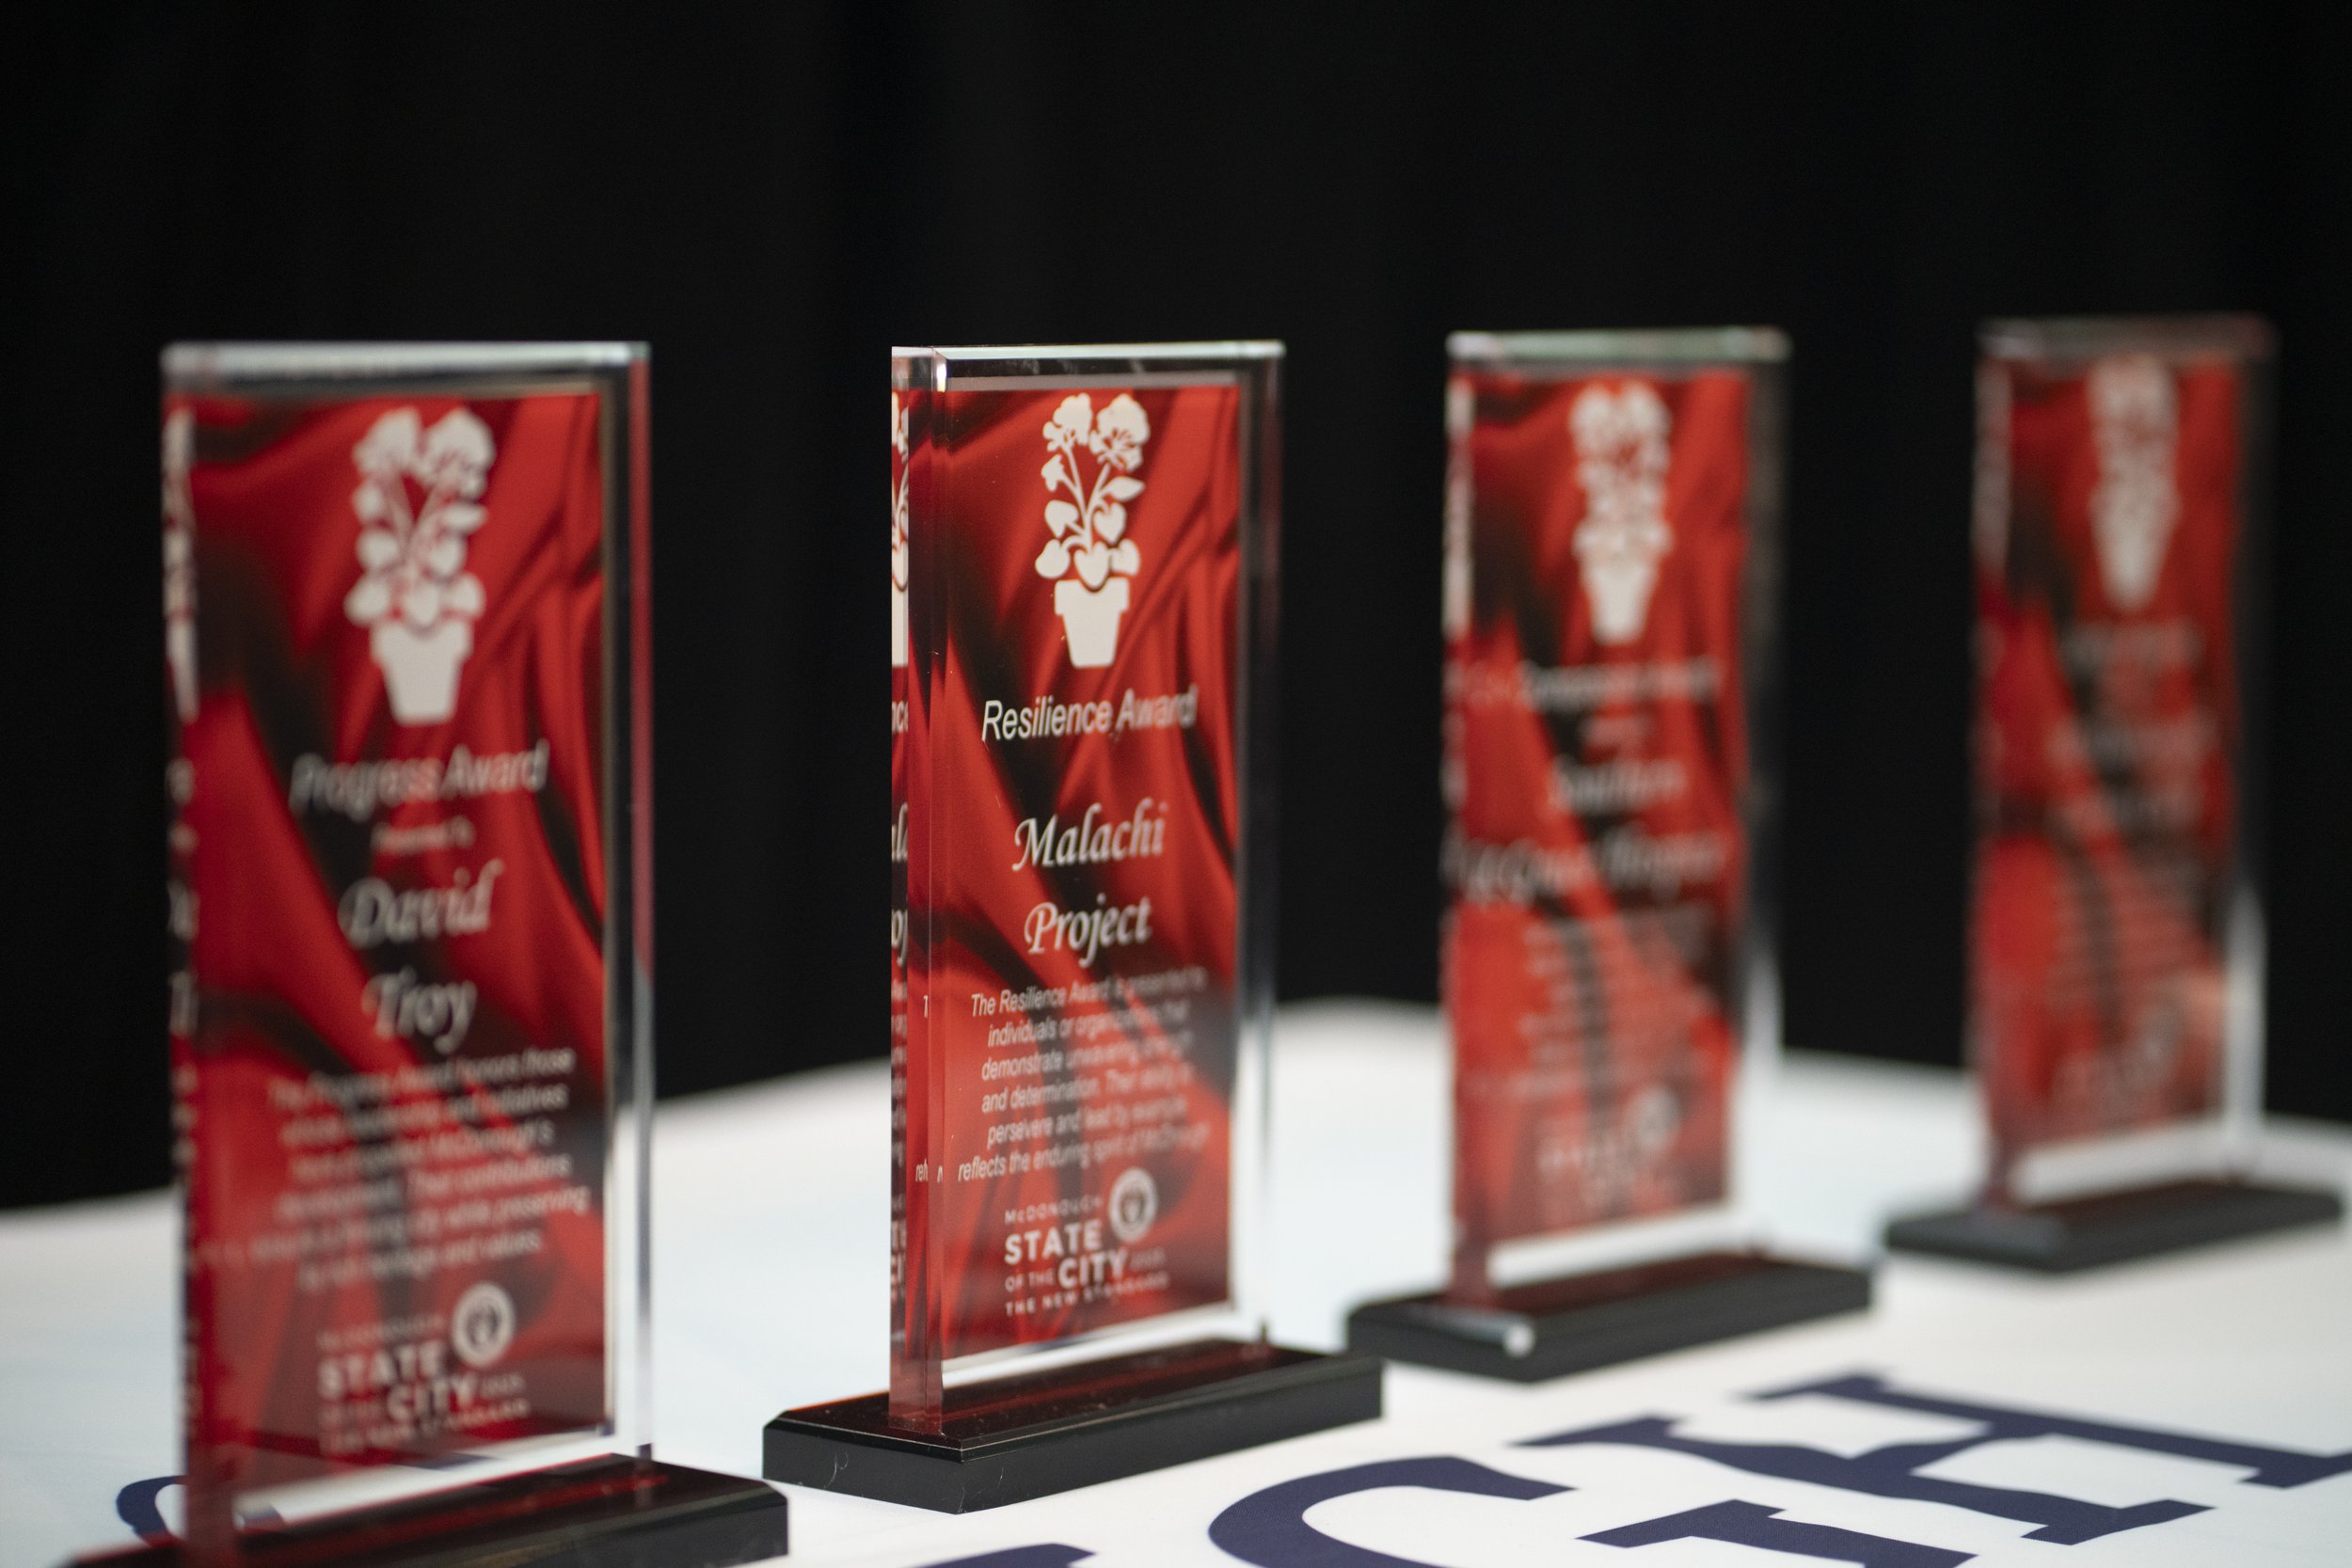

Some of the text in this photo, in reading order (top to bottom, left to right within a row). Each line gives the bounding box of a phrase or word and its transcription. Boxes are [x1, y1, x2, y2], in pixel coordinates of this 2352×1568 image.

[981, 685, 1198, 741] Resilience Award
[290, 738, 550, 822] Progress Award
[1011, 797, 1168, 871] Malachi
[338, 859, 504, 949] David
[1024, 892, 1152, 969] Project
[361, 965, 478, 1054] Troy
[971, 992, 996, 1017] The
[999, 984, 1066, 1014] Resilience
[988, 1017, 1057, 1048] individuals
[981, 1049, 1064, 1082] demonstrate
[981, 1089, 1008, 1115] and
[988, 1115, 1054, 1149] persevere
[957, 1152, 1007, 1183] reflects
[1009, 1146, 1030, 1173] the
[1004, 1219, 1103, 1266] STATE
[1005, 1270, 1025, 1293] OF
[1057, 1248, 1128, 1290] CITY
[1004, 1300, 1036, 1318] THE
[316, 1338, 450, 1402] STATE
[387, 1372, 478, 1423] CITY
